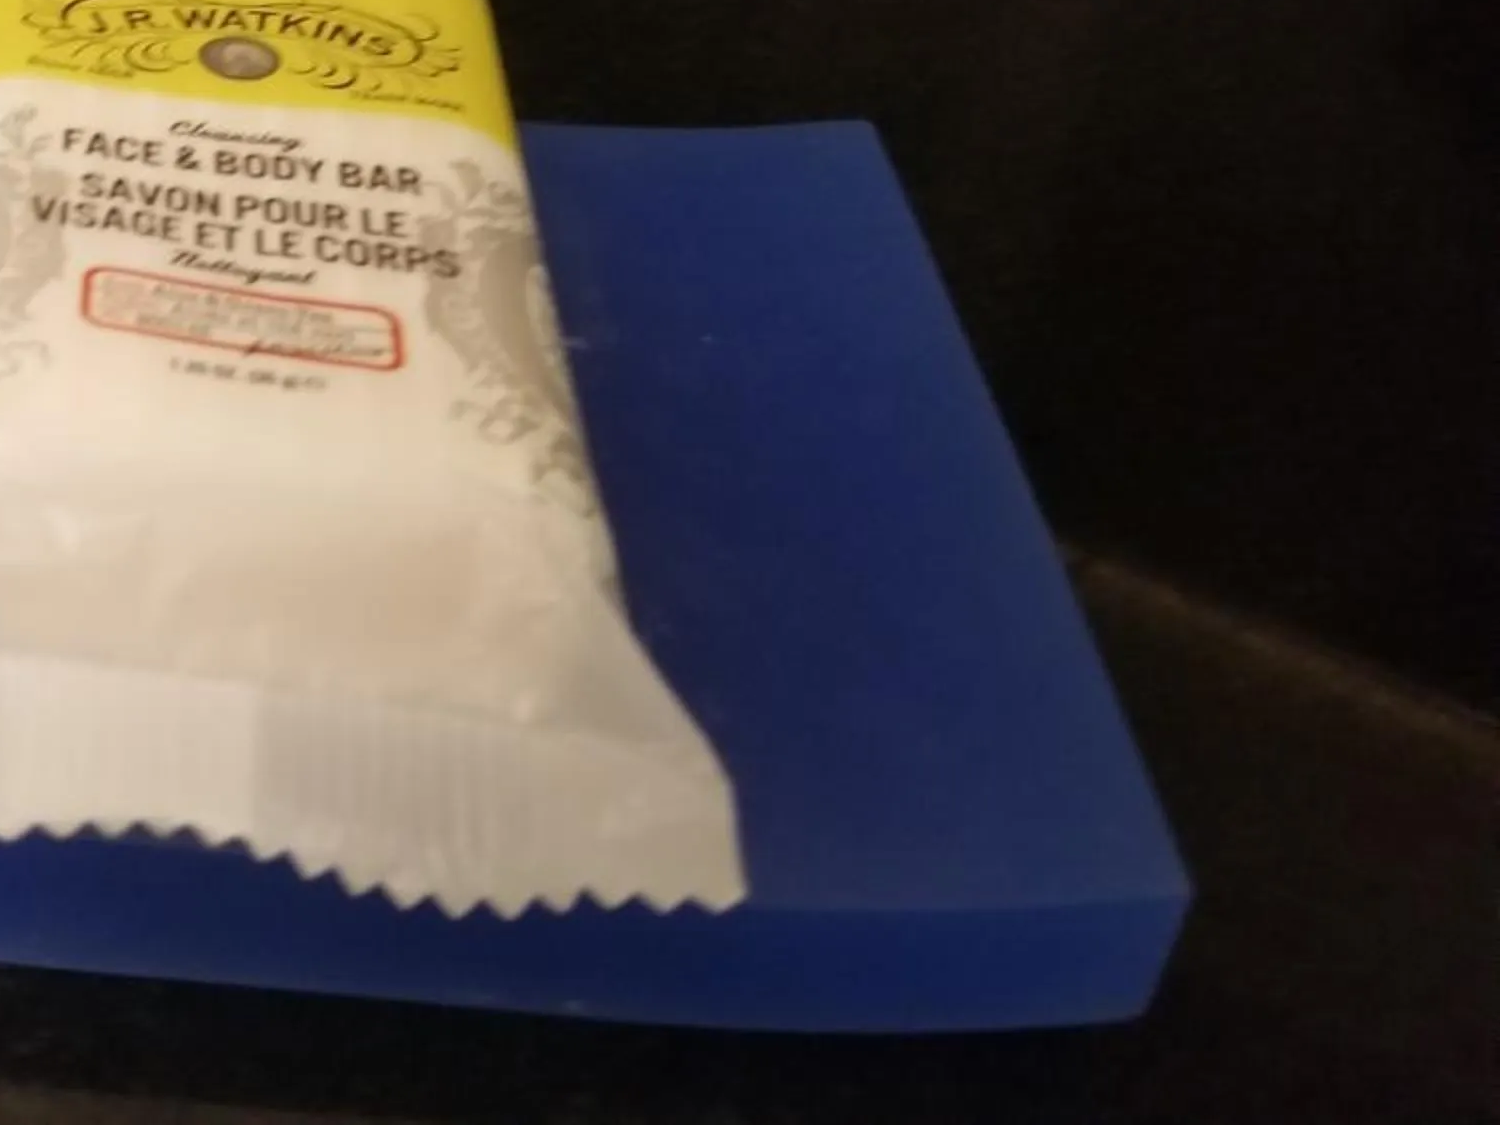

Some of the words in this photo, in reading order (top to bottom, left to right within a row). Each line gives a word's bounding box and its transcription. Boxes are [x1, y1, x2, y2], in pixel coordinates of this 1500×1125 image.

[171, 8, 395, 57] WATKINS
[62, 128, 164, 166] FACE
[175, 146, 201, 171] &
[213, 150, 324, 184] BODY
[337, 161, 423, 195] BAR
[169, 120, 305, 152] Cleansing
[30, 195, 183, 241] VISAGE
[195, 223, 240, 252] ET
[255, 230, 304, 259] LE
[314, 236, 463, 278] CORPS
[80, 173, 221, 217] SAVON
[234, 195, 348, 232] POUR
[361, 208, 408, 239] LE
